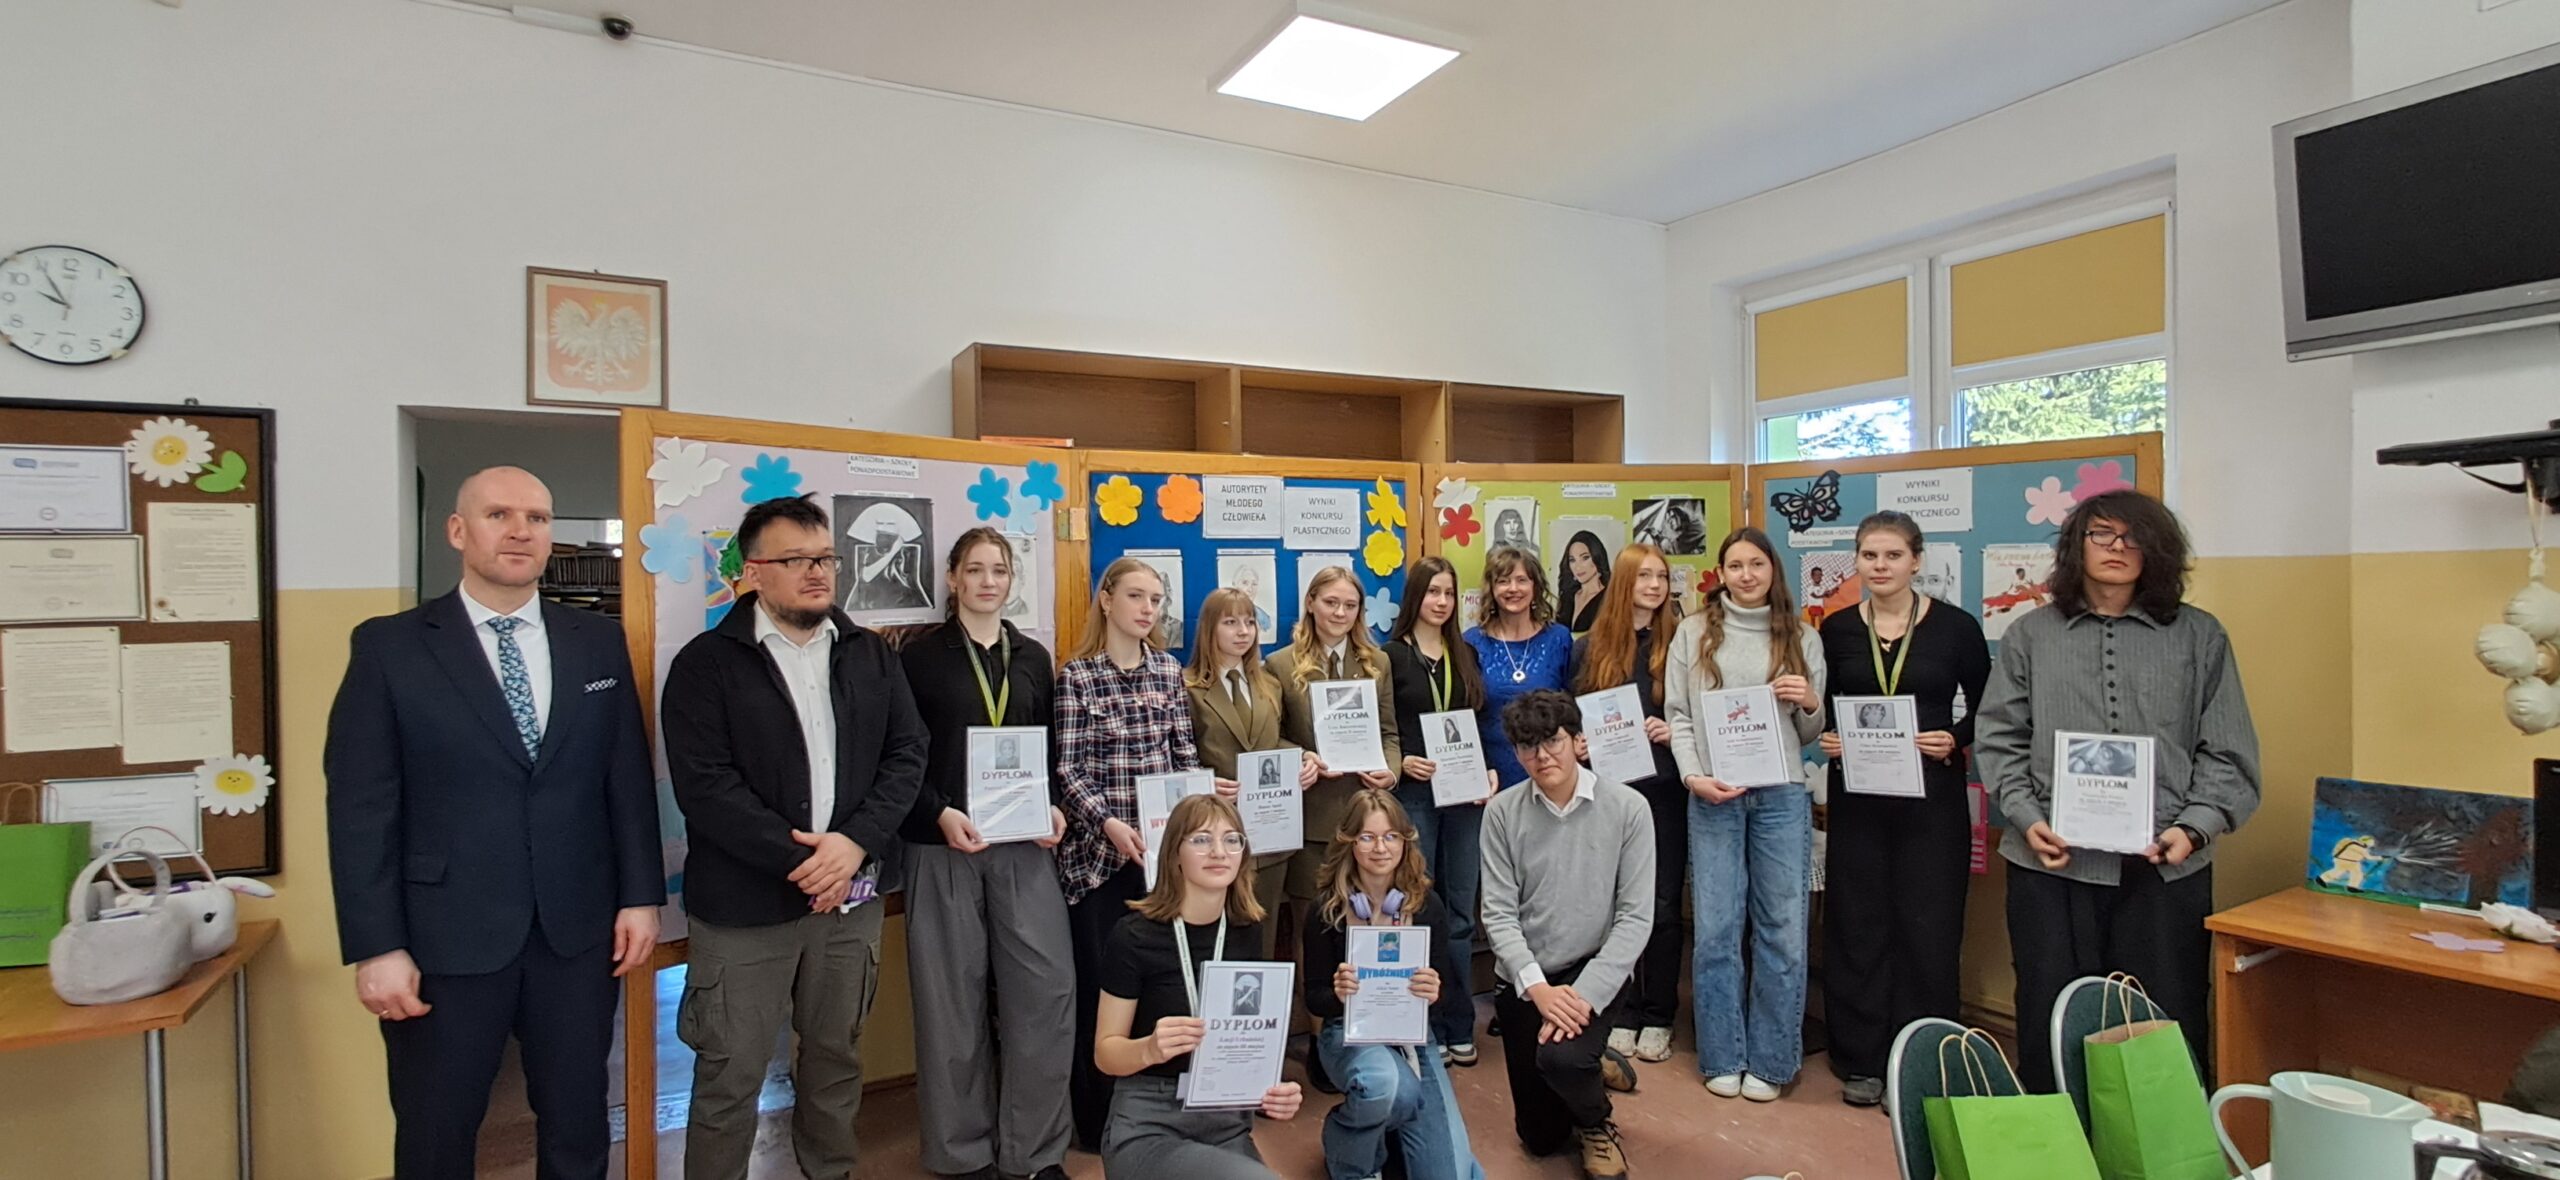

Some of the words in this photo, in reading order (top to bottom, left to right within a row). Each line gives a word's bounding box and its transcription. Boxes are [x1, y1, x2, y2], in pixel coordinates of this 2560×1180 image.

[63, 258, 79, 272] 12
[112, 284, 126, 299] 2
[120, 307, 134, 321] 3
[89, 339, 102, 353] 5
[1221, 484, 1267, 494] AUTORYTETY
[1905, 480, 1940, 489] WYNIKI
[1225, 498, 1263, 508] MŁODEGO
[1308, 497, 1336, 506] WYNIKI
[1897, 493, 1950, 504] KONKURSU
[1222, 512, 1266, 522] CZŁOWIEKA
[1301, 511, 1343, 520] KONKURSU
[1293, 526, 1351, 536] PLASTYCZNEGO
[1595, 720, 1635, 736] DYPLOM
[1718, 723, 1767, 735] DYPLOM
[1848, 731, 1906, 739] DYPLOM
[1435, 742, 1474, 754] DYPLOM
[982, 770, 1033, 780] DYPLOM
[2077, 777, 2128, 790] DYPLOM
[1246, 789, 1292, 801] DYPLOM
[1210, 1018, 1278, 1031] DYPLOM
